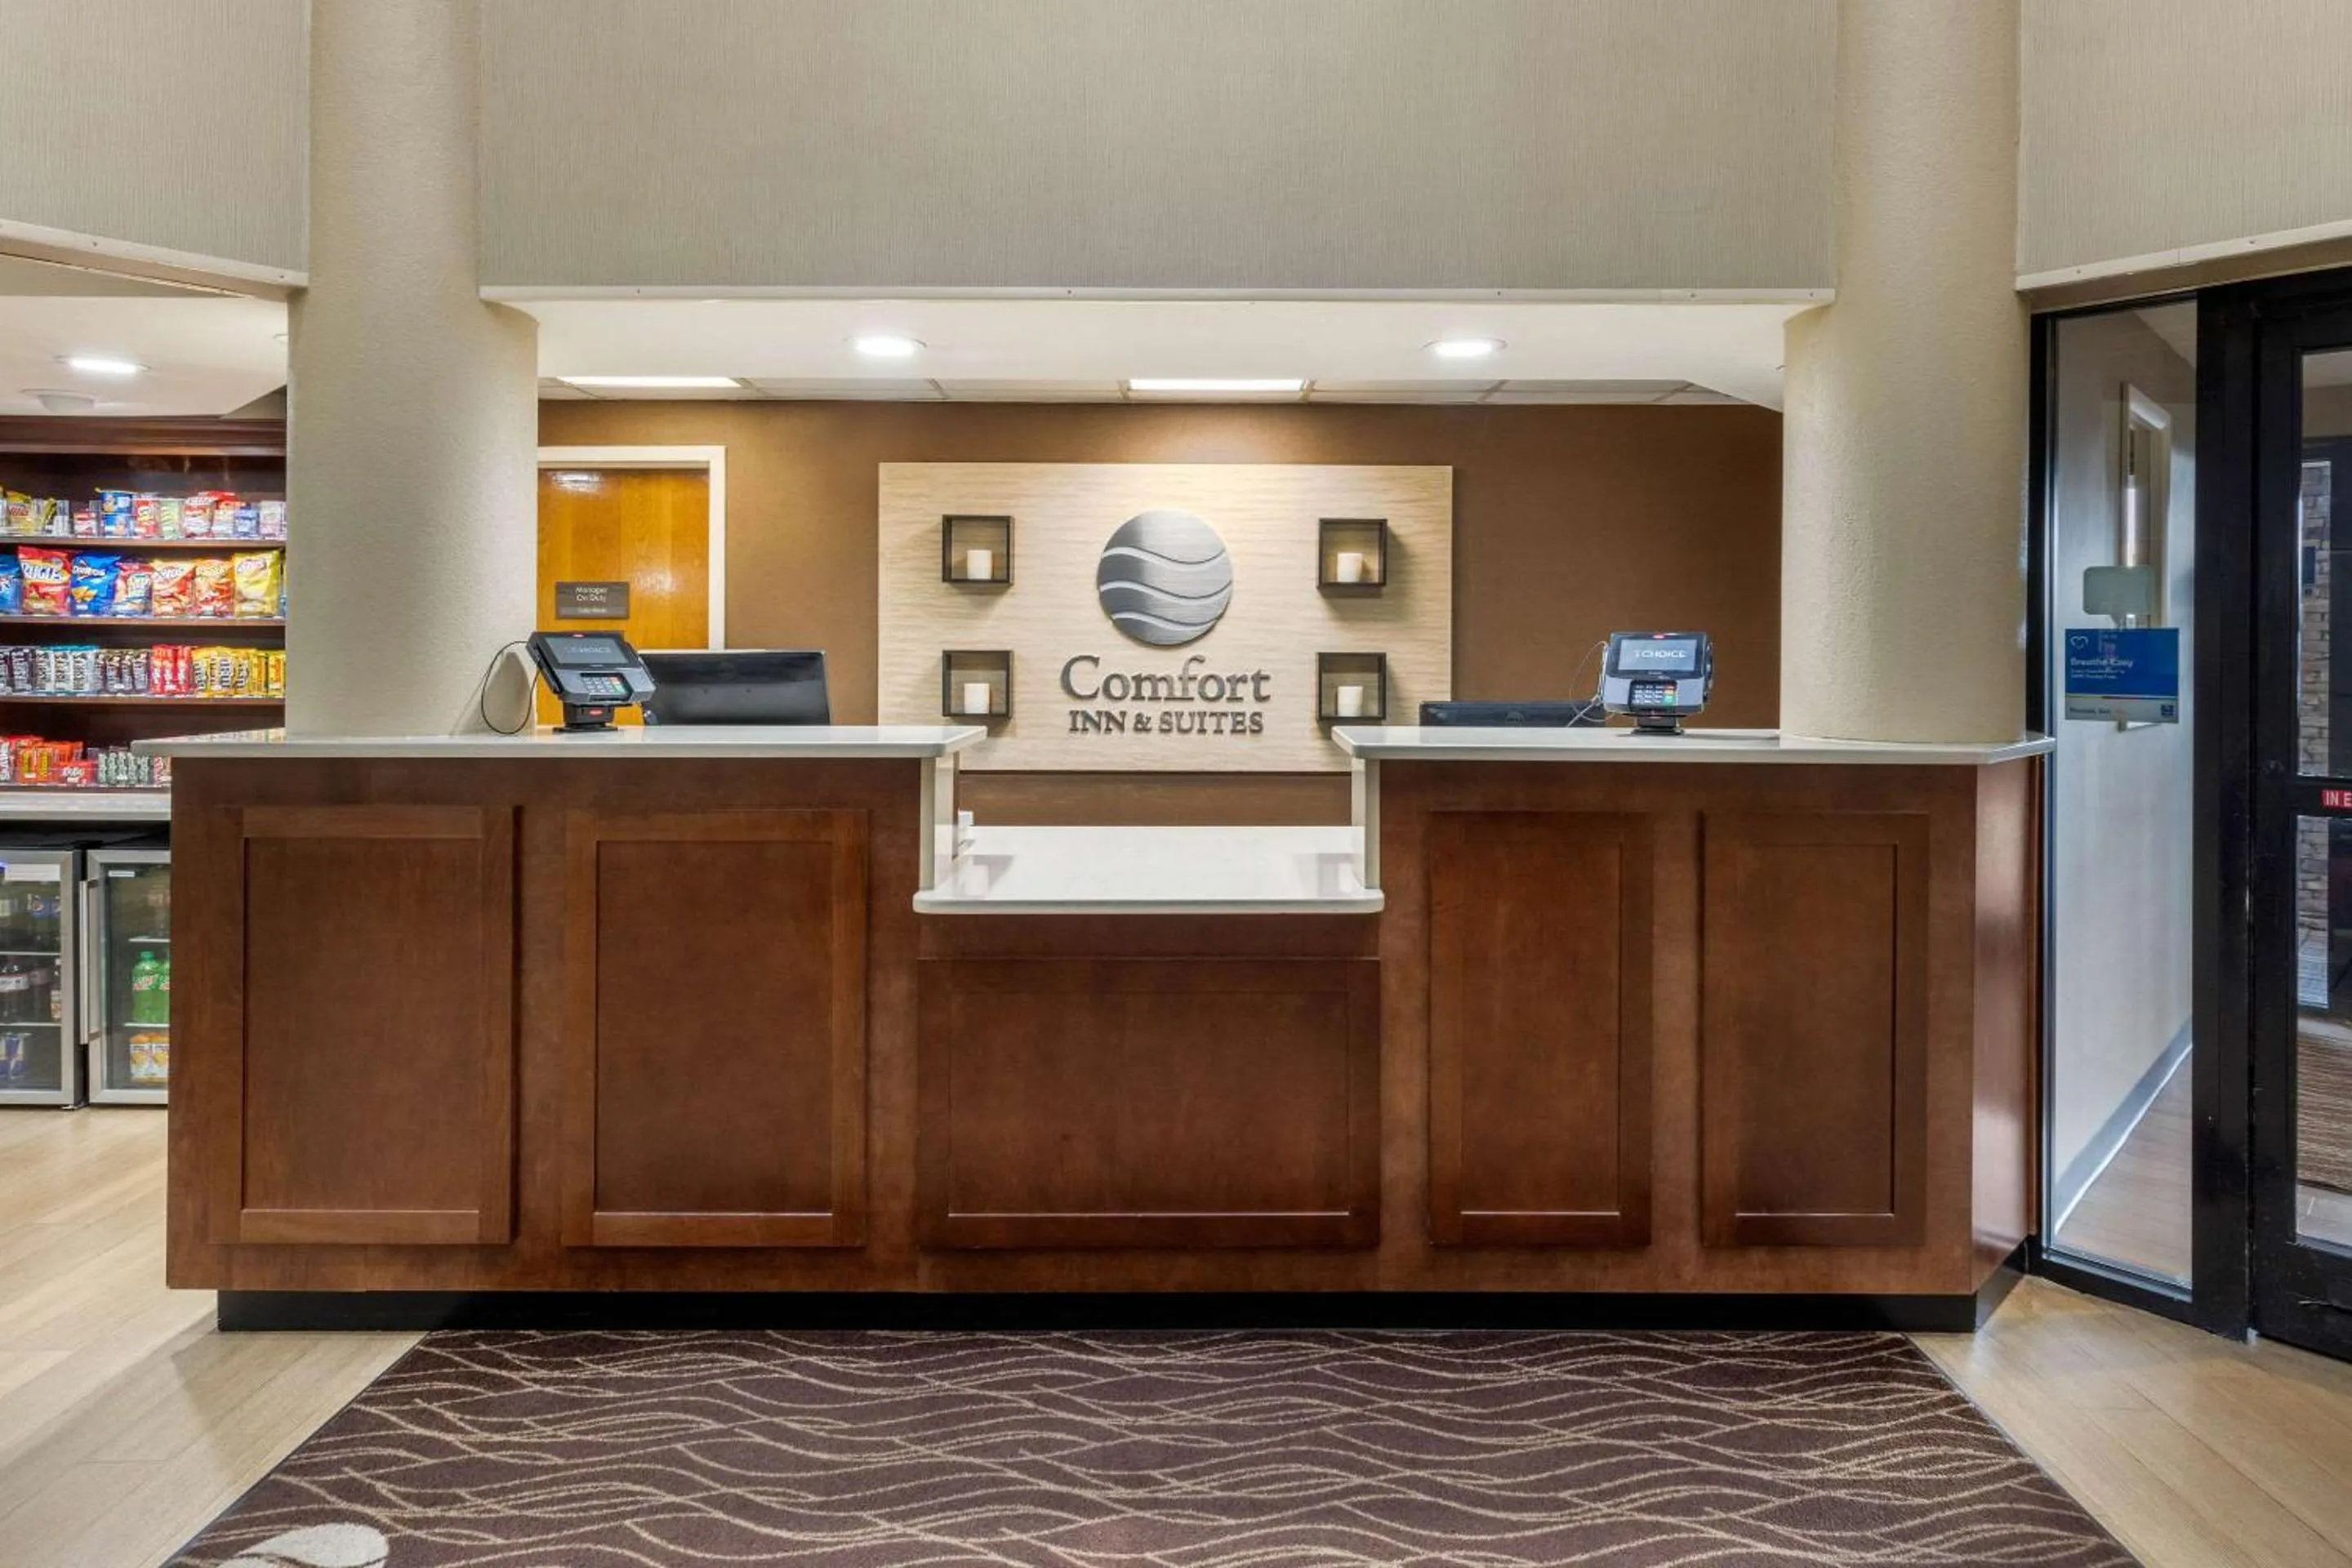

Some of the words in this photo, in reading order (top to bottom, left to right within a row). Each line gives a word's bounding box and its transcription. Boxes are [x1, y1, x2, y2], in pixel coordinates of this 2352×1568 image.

[1060, 654, 1271, 702] Comfort
[1068, 710, 1127, 733] INN
[1133, 711, 1152, 733] &
[1159, 710, 1264, 734] SUITES
[2326, 790, 2339, 806] IN
